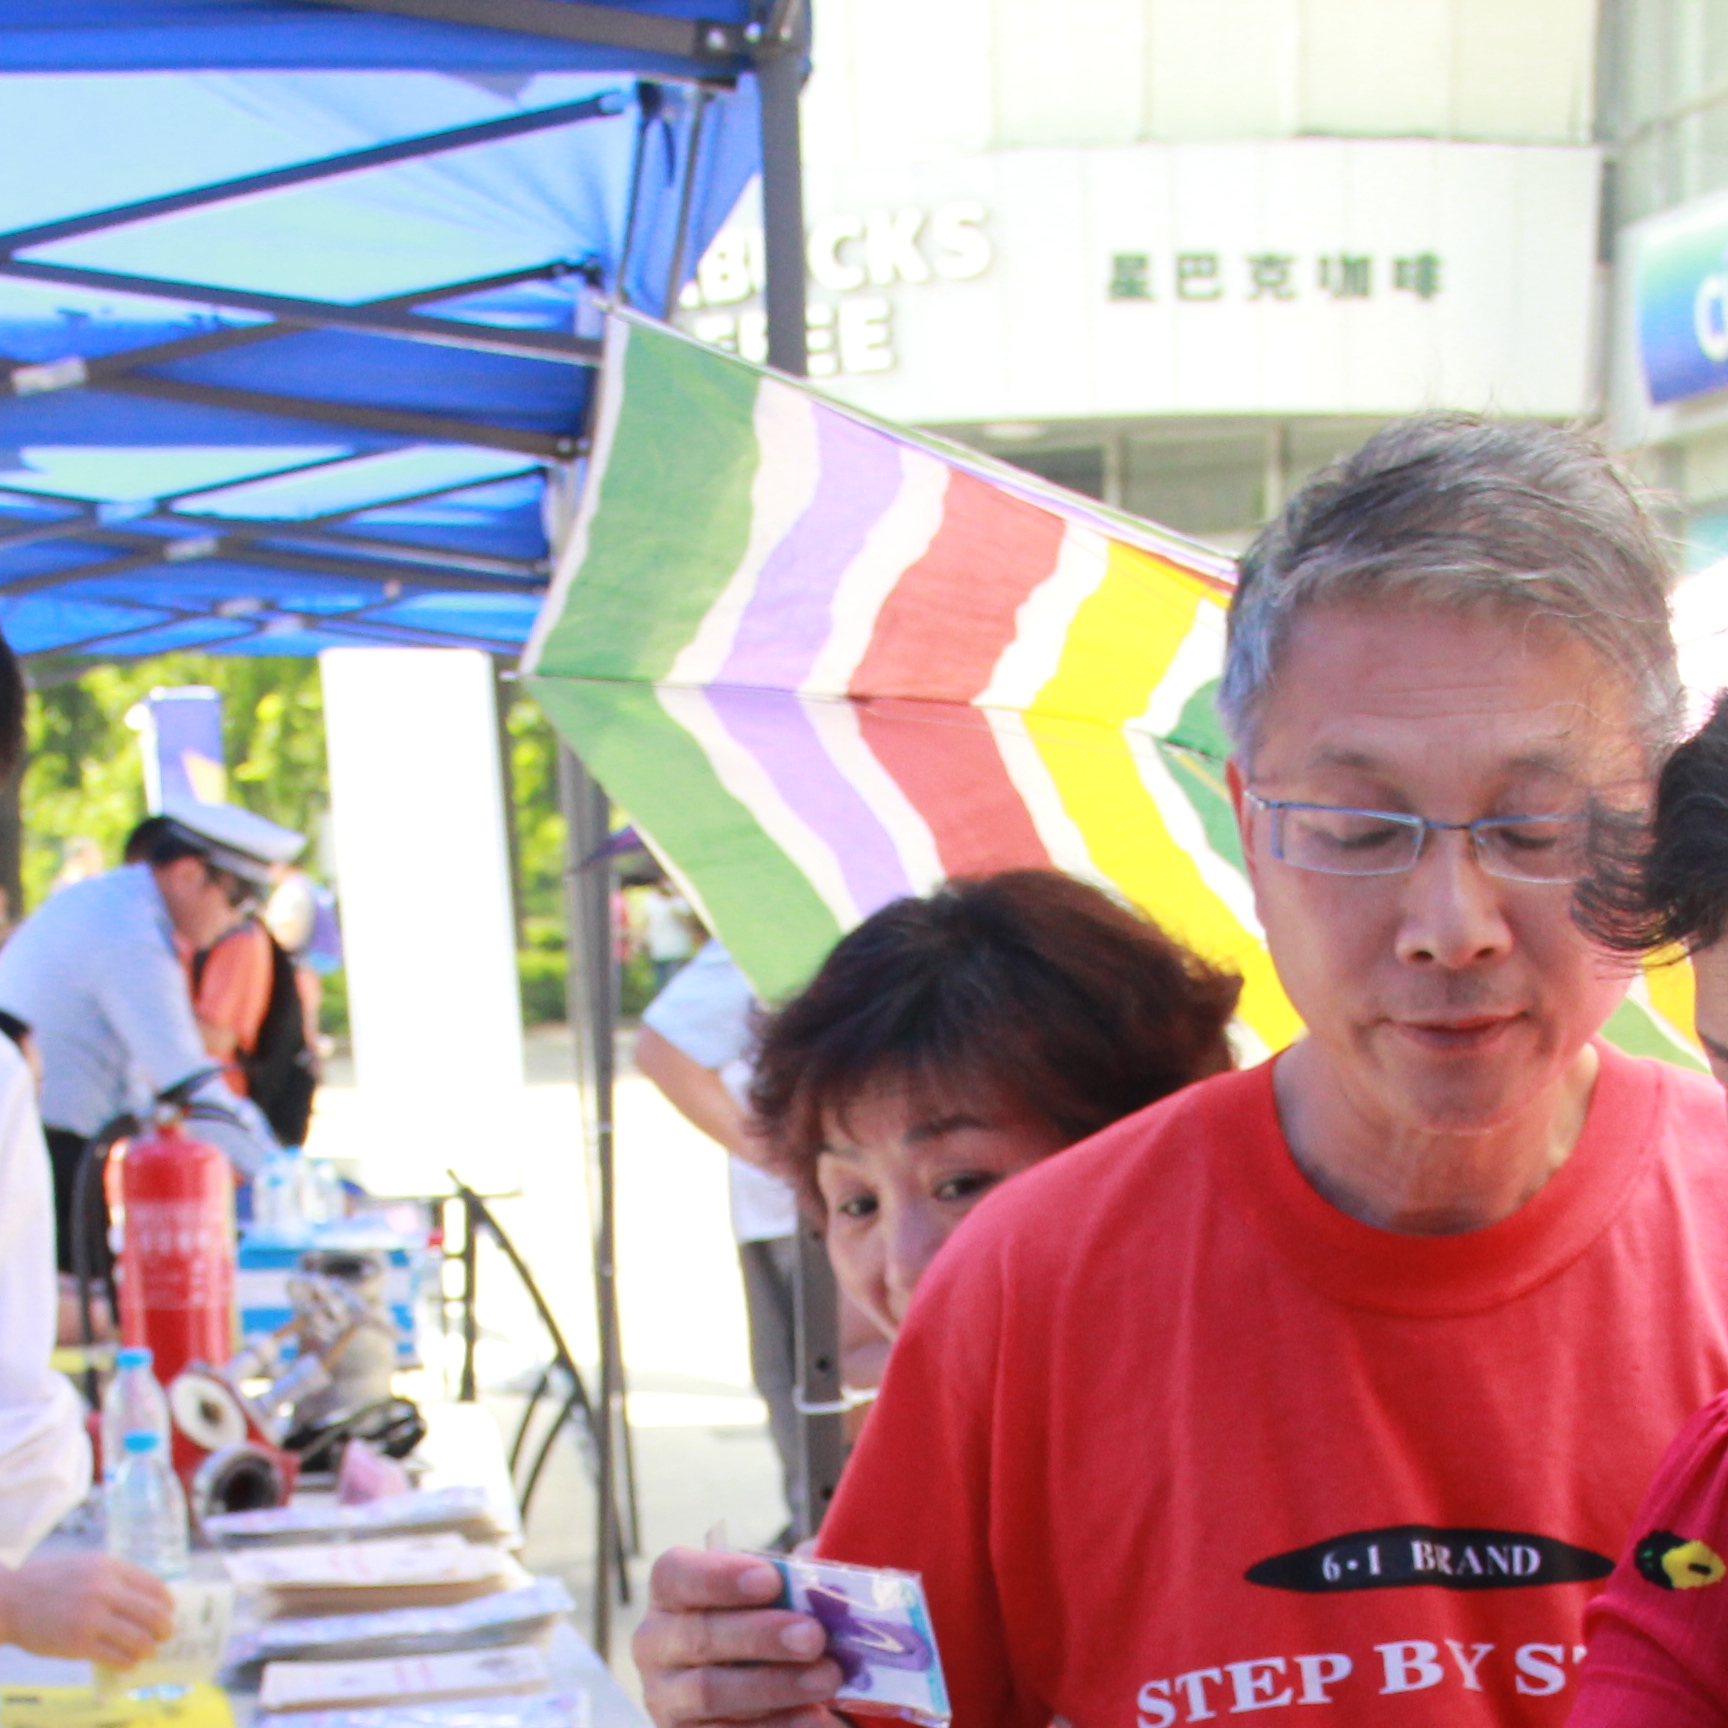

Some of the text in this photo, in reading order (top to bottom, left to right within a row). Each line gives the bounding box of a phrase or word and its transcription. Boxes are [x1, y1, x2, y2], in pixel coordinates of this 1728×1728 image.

[1108, 252, 1442, 302] 星巴克咖啡
[1411, 1540, 1541, 1577] BRAND
[1373, 1639, 1494, 1695] BY
[1514, 1642, 1588, 1696] S
